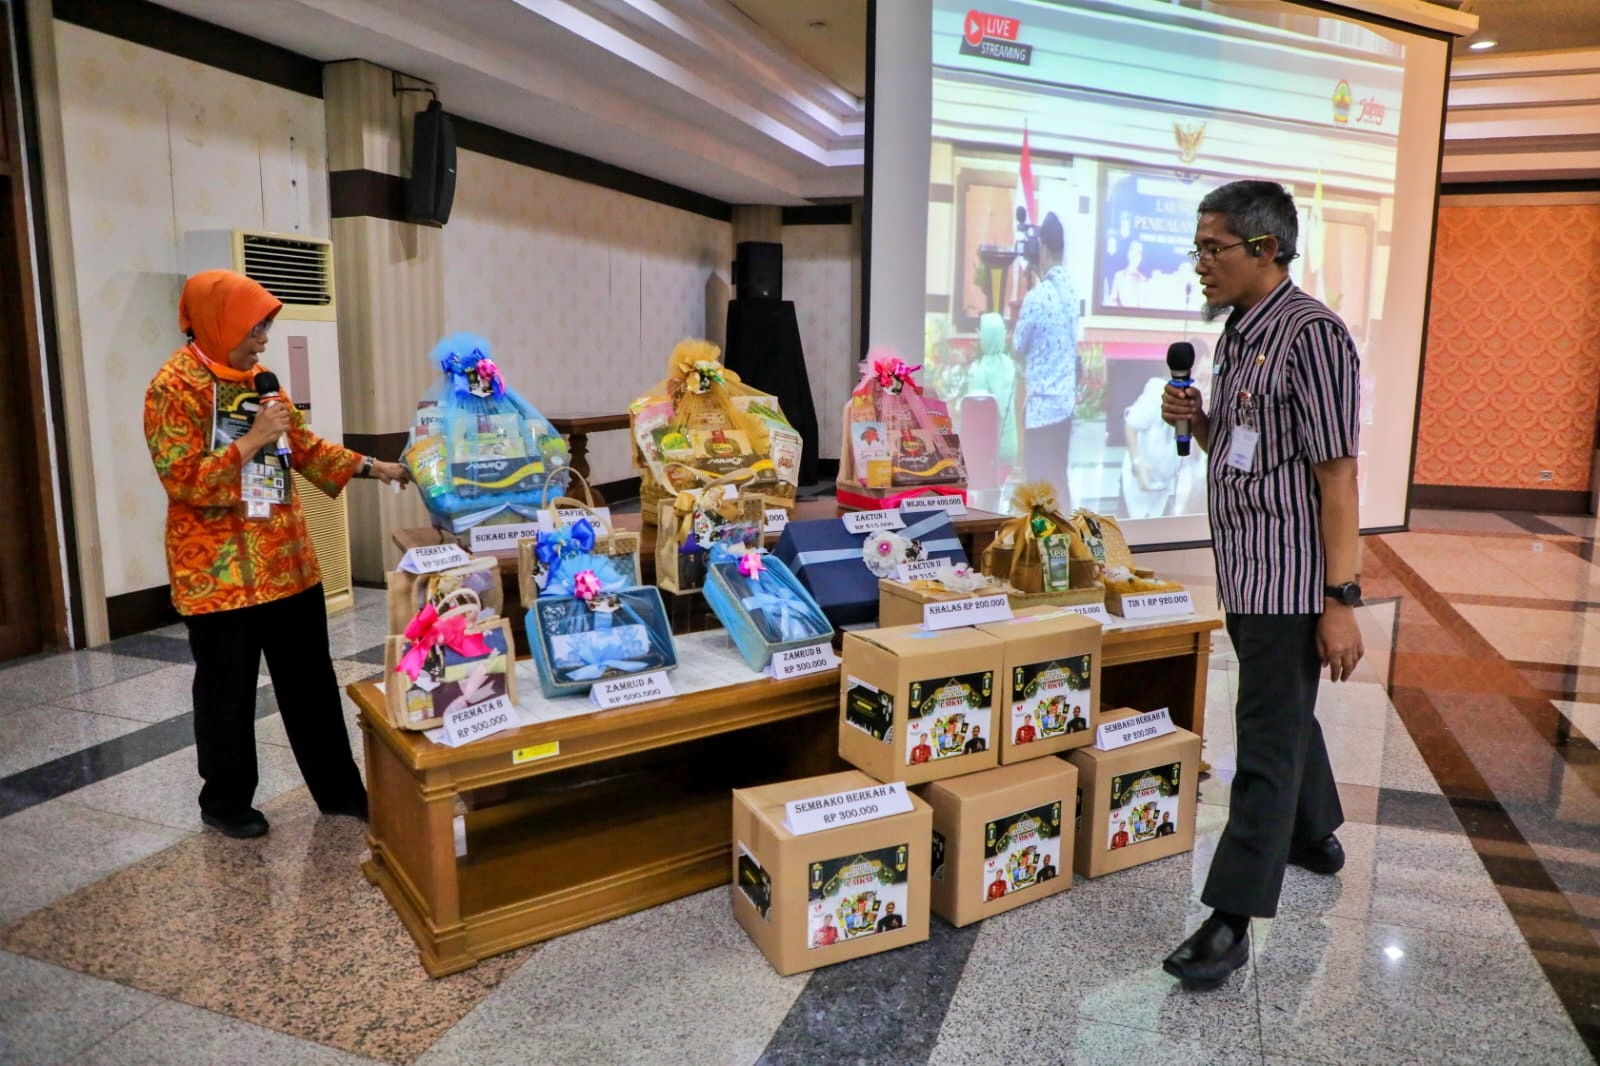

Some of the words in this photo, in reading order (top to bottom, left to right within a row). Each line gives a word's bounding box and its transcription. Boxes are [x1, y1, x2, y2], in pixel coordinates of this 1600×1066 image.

[986, 17, 1010, 36] LIVE
[981, 41, 1027, 61] STREAMING
[475, 532, 507, 542] SUKARI
[508, 531, 519, 539] RP
[1050, 547, 1066, 557] tea
[929, 605, 962, 614] KHALAS
[974, 599, 1005, 609] 200.000
[1147, 598, 1157, 606] RP
[783, 648, 815, 661] ZAMRUD
[784, 665, 795, 673] RP
[795, 659, 827, 671] 300.000
[605, 679, 645, 693] ZAMRUD
[647, 677, 654, 685] A
[452, 703, 496, 724] PERMATA
[496, 699, 504, 709] B
[457, 728, 470, 738] RP
[471, 714, 508, 733] 300.000
[1104, 719, 1135, 733] SEMBAKO
[1135, 712, 1160, 725] BERKAH
[1123, 734, 1132, 742] RP
[795, 796, 845, 814] SEMBAKO
[845, 788, 887, 803] BERKAH
[889, 785, 897, 794] A
[823, 813, 838, 823] RP
[839, 804, 879, 820] 300.000
